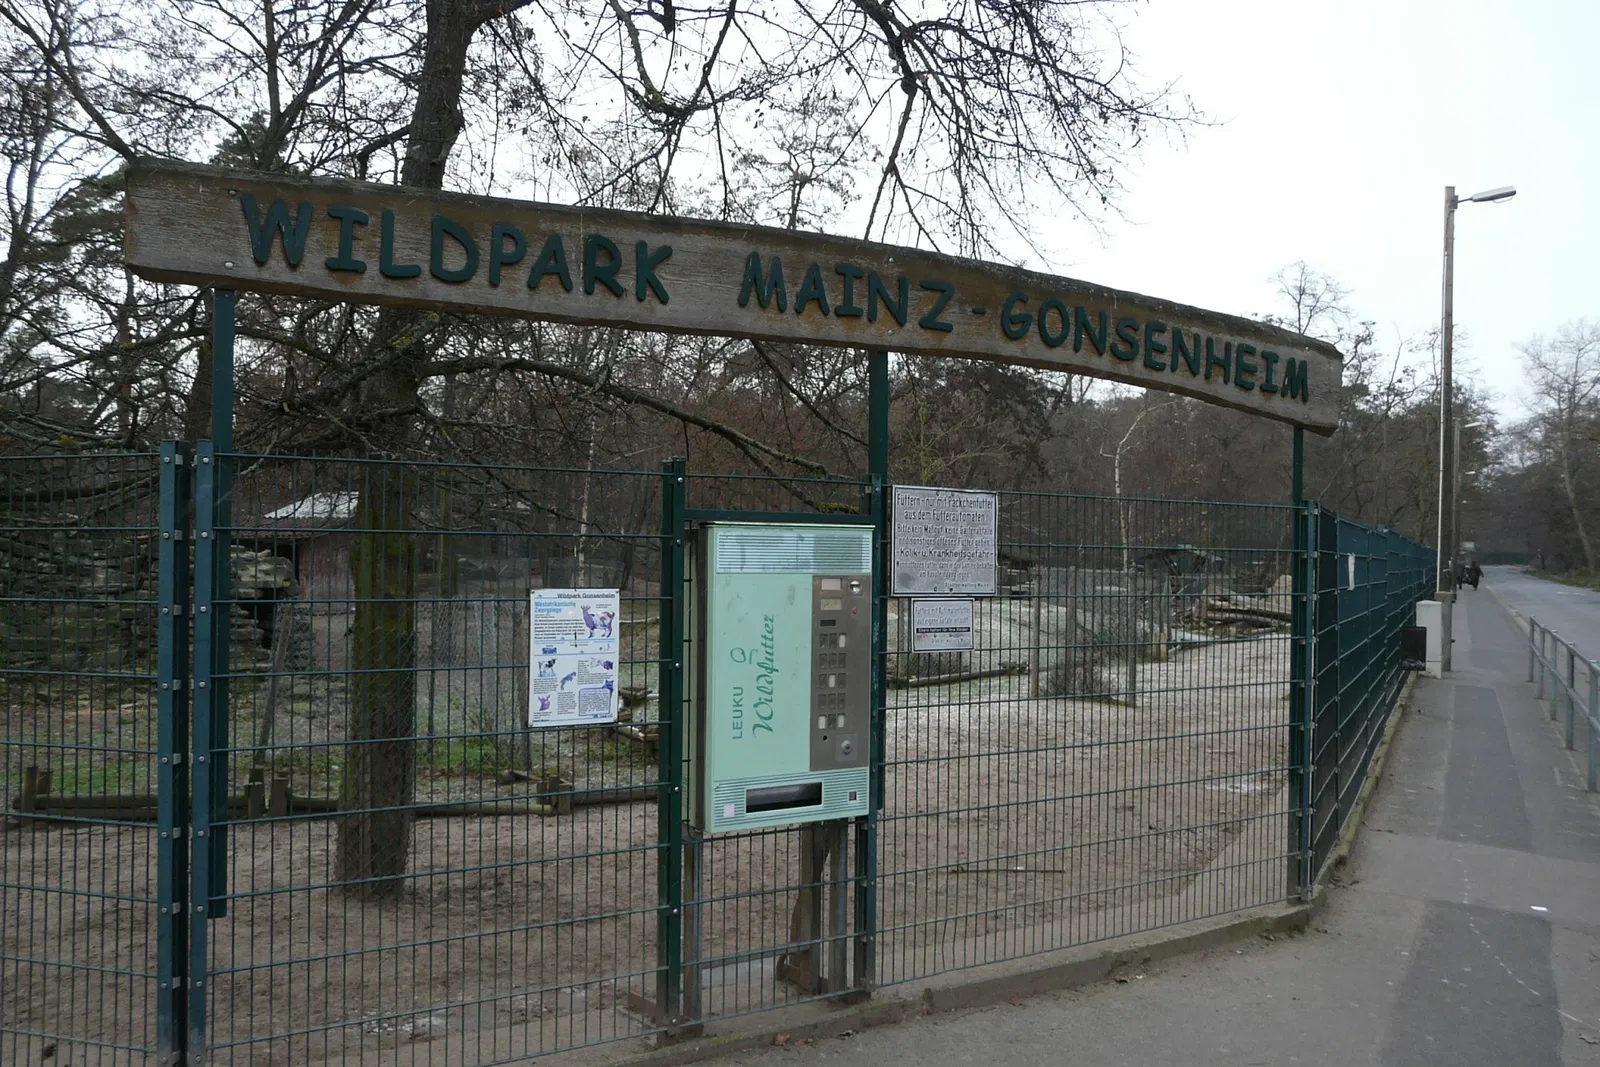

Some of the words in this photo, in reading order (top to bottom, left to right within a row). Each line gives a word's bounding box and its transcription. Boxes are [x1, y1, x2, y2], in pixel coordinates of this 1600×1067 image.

[239, 192, 674, 304] WILDPARK
[904, 511, 917, 520] aus
[917, 508, 931, 521] dem
[557, 592, 582, 600] Wildpark
[583, 592, 616, 600] Gonsenheim
[752, 614, 780, 740] Wildfutter
[732, 686, 744, 740] LEUKU
